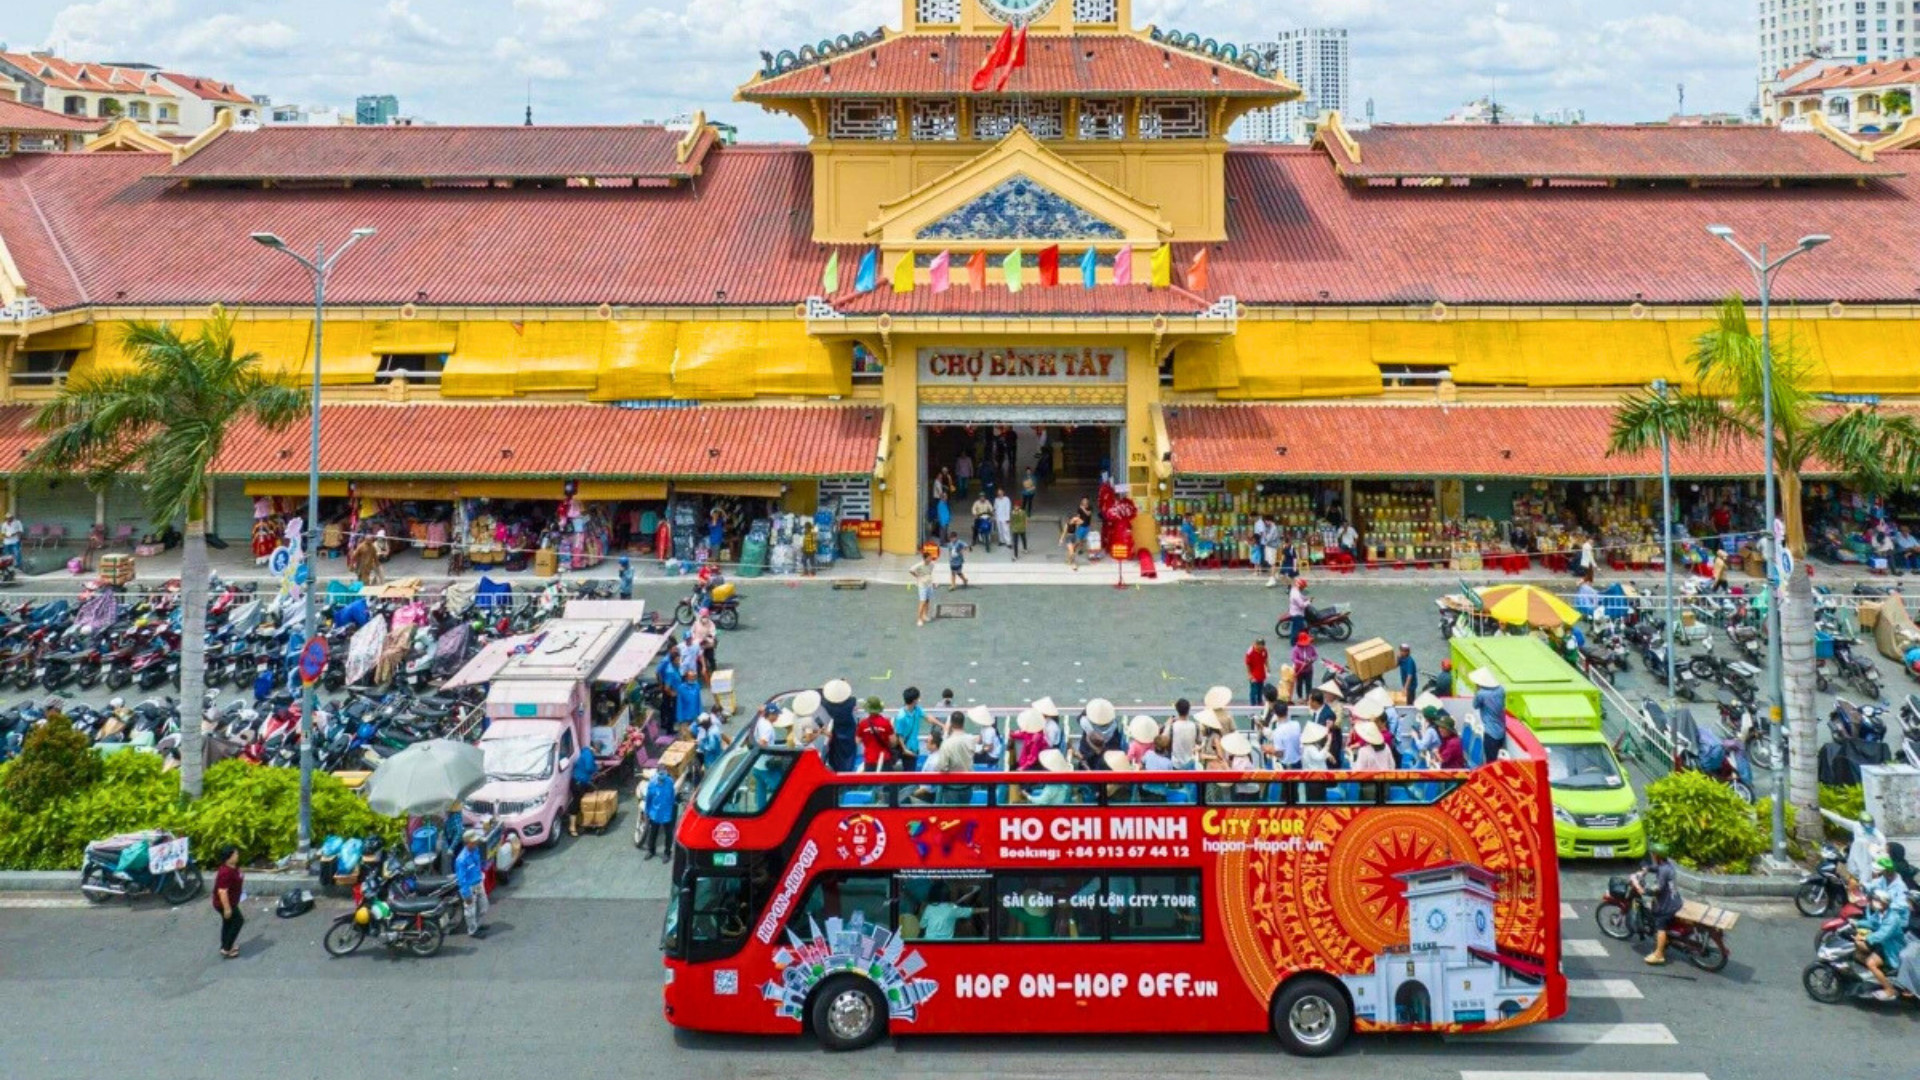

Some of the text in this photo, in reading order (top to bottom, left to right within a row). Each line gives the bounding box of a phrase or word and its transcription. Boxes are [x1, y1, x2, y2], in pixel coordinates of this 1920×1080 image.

[929, 348, 1114, 381] CHỢ BÌNH TÂY
[1000, 816, 1188, 841] HO CHI MINH
[1000, 845, 1190, 860] Booking: +84 913 67 44 12
[1202, 836, 1325, 855] hopon-hopoff.vn
[757, 911, 778, 944] HOP
[799, 840, 819, 869] OFF
[1002, 892, 1024, 908] SÀI
[1028, 892, 1053, 908] GÒN
[1070, 893, 1096, 910] CHỢ
[1129, 895, 1157, 908] CITY
[1162, 895, 1196, 908] TOUR
[955, 973, 1010, 998] HOP
[1138, 973, 1218, 998] OFF.VN
